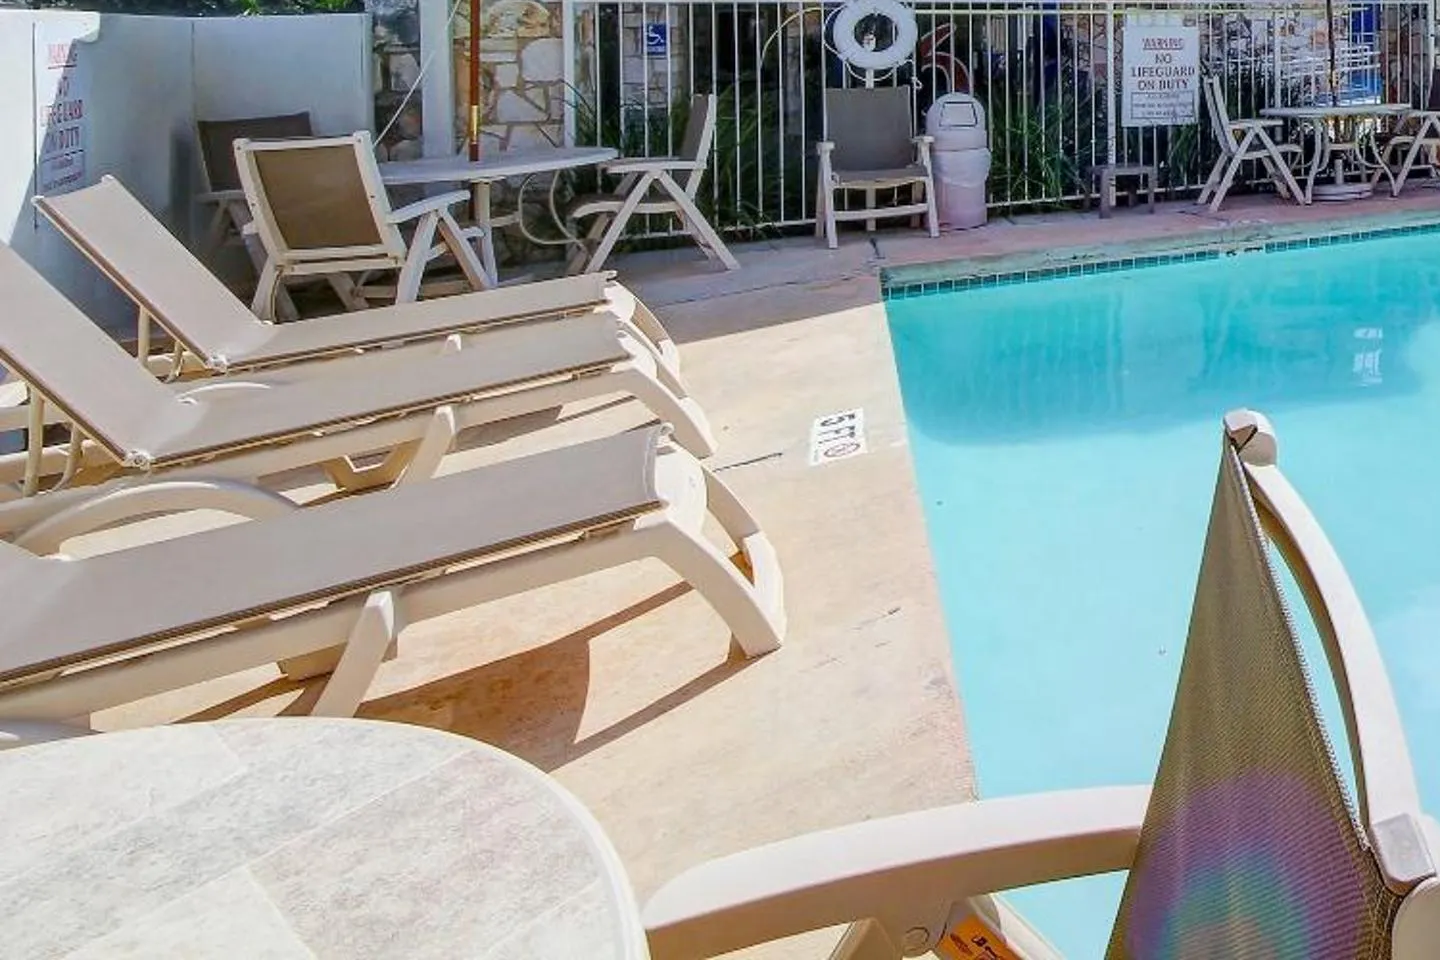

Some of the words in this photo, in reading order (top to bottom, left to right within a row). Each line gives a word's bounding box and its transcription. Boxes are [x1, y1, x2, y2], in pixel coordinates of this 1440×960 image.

[1154, 53, 1172, 65] NO
[1131, 66, 1196, 78] LIFEGUARD
[1137, 79, 1155, 91] ON
[1159, 79, 1189, 91] DUTY
